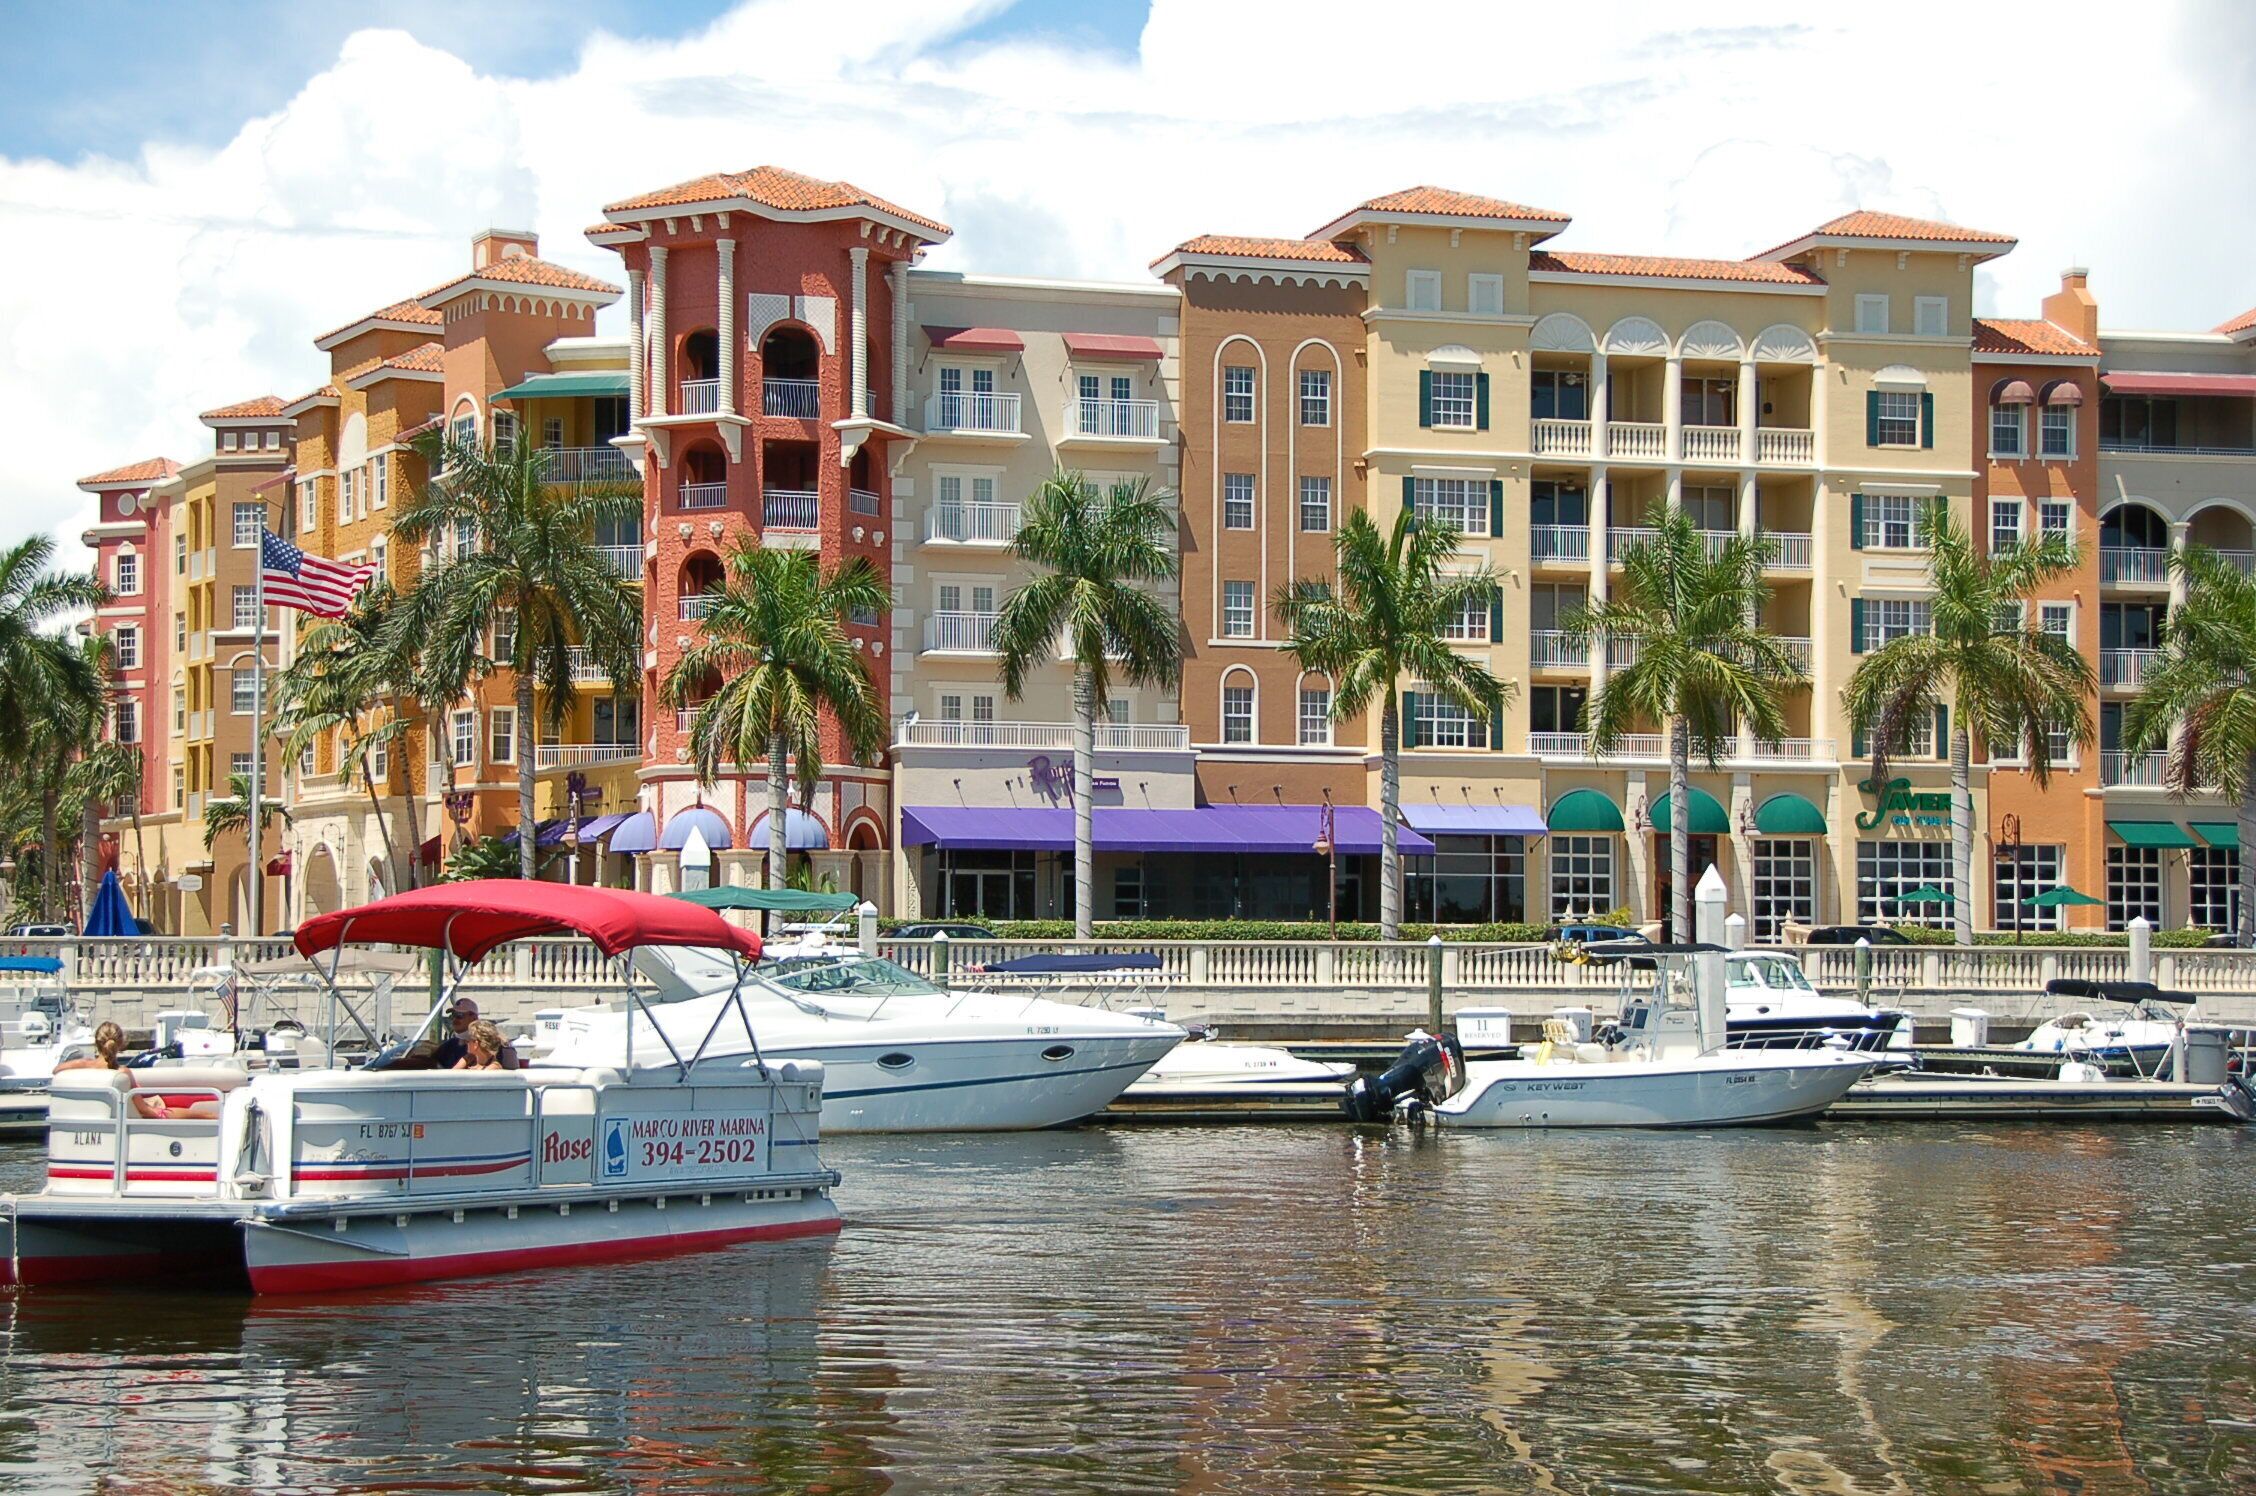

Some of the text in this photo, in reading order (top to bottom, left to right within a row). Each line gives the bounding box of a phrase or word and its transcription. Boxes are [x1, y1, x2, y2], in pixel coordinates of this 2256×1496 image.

[1855, 778, 1972, 830] TAVER
[1527, 1082, 1586, 1091] KEY WEST
[74, 1131, 101, 1145] ALANA
[360, 1125, 373, 1138] FL
[378, 1124, 398, 1138] 8767
[632, 1117, 765, 1138] MARCO RIVER MARINA
[544, 1130, 592, 1163] Rose
[641, 1139, 755, 1166] 394-2502
